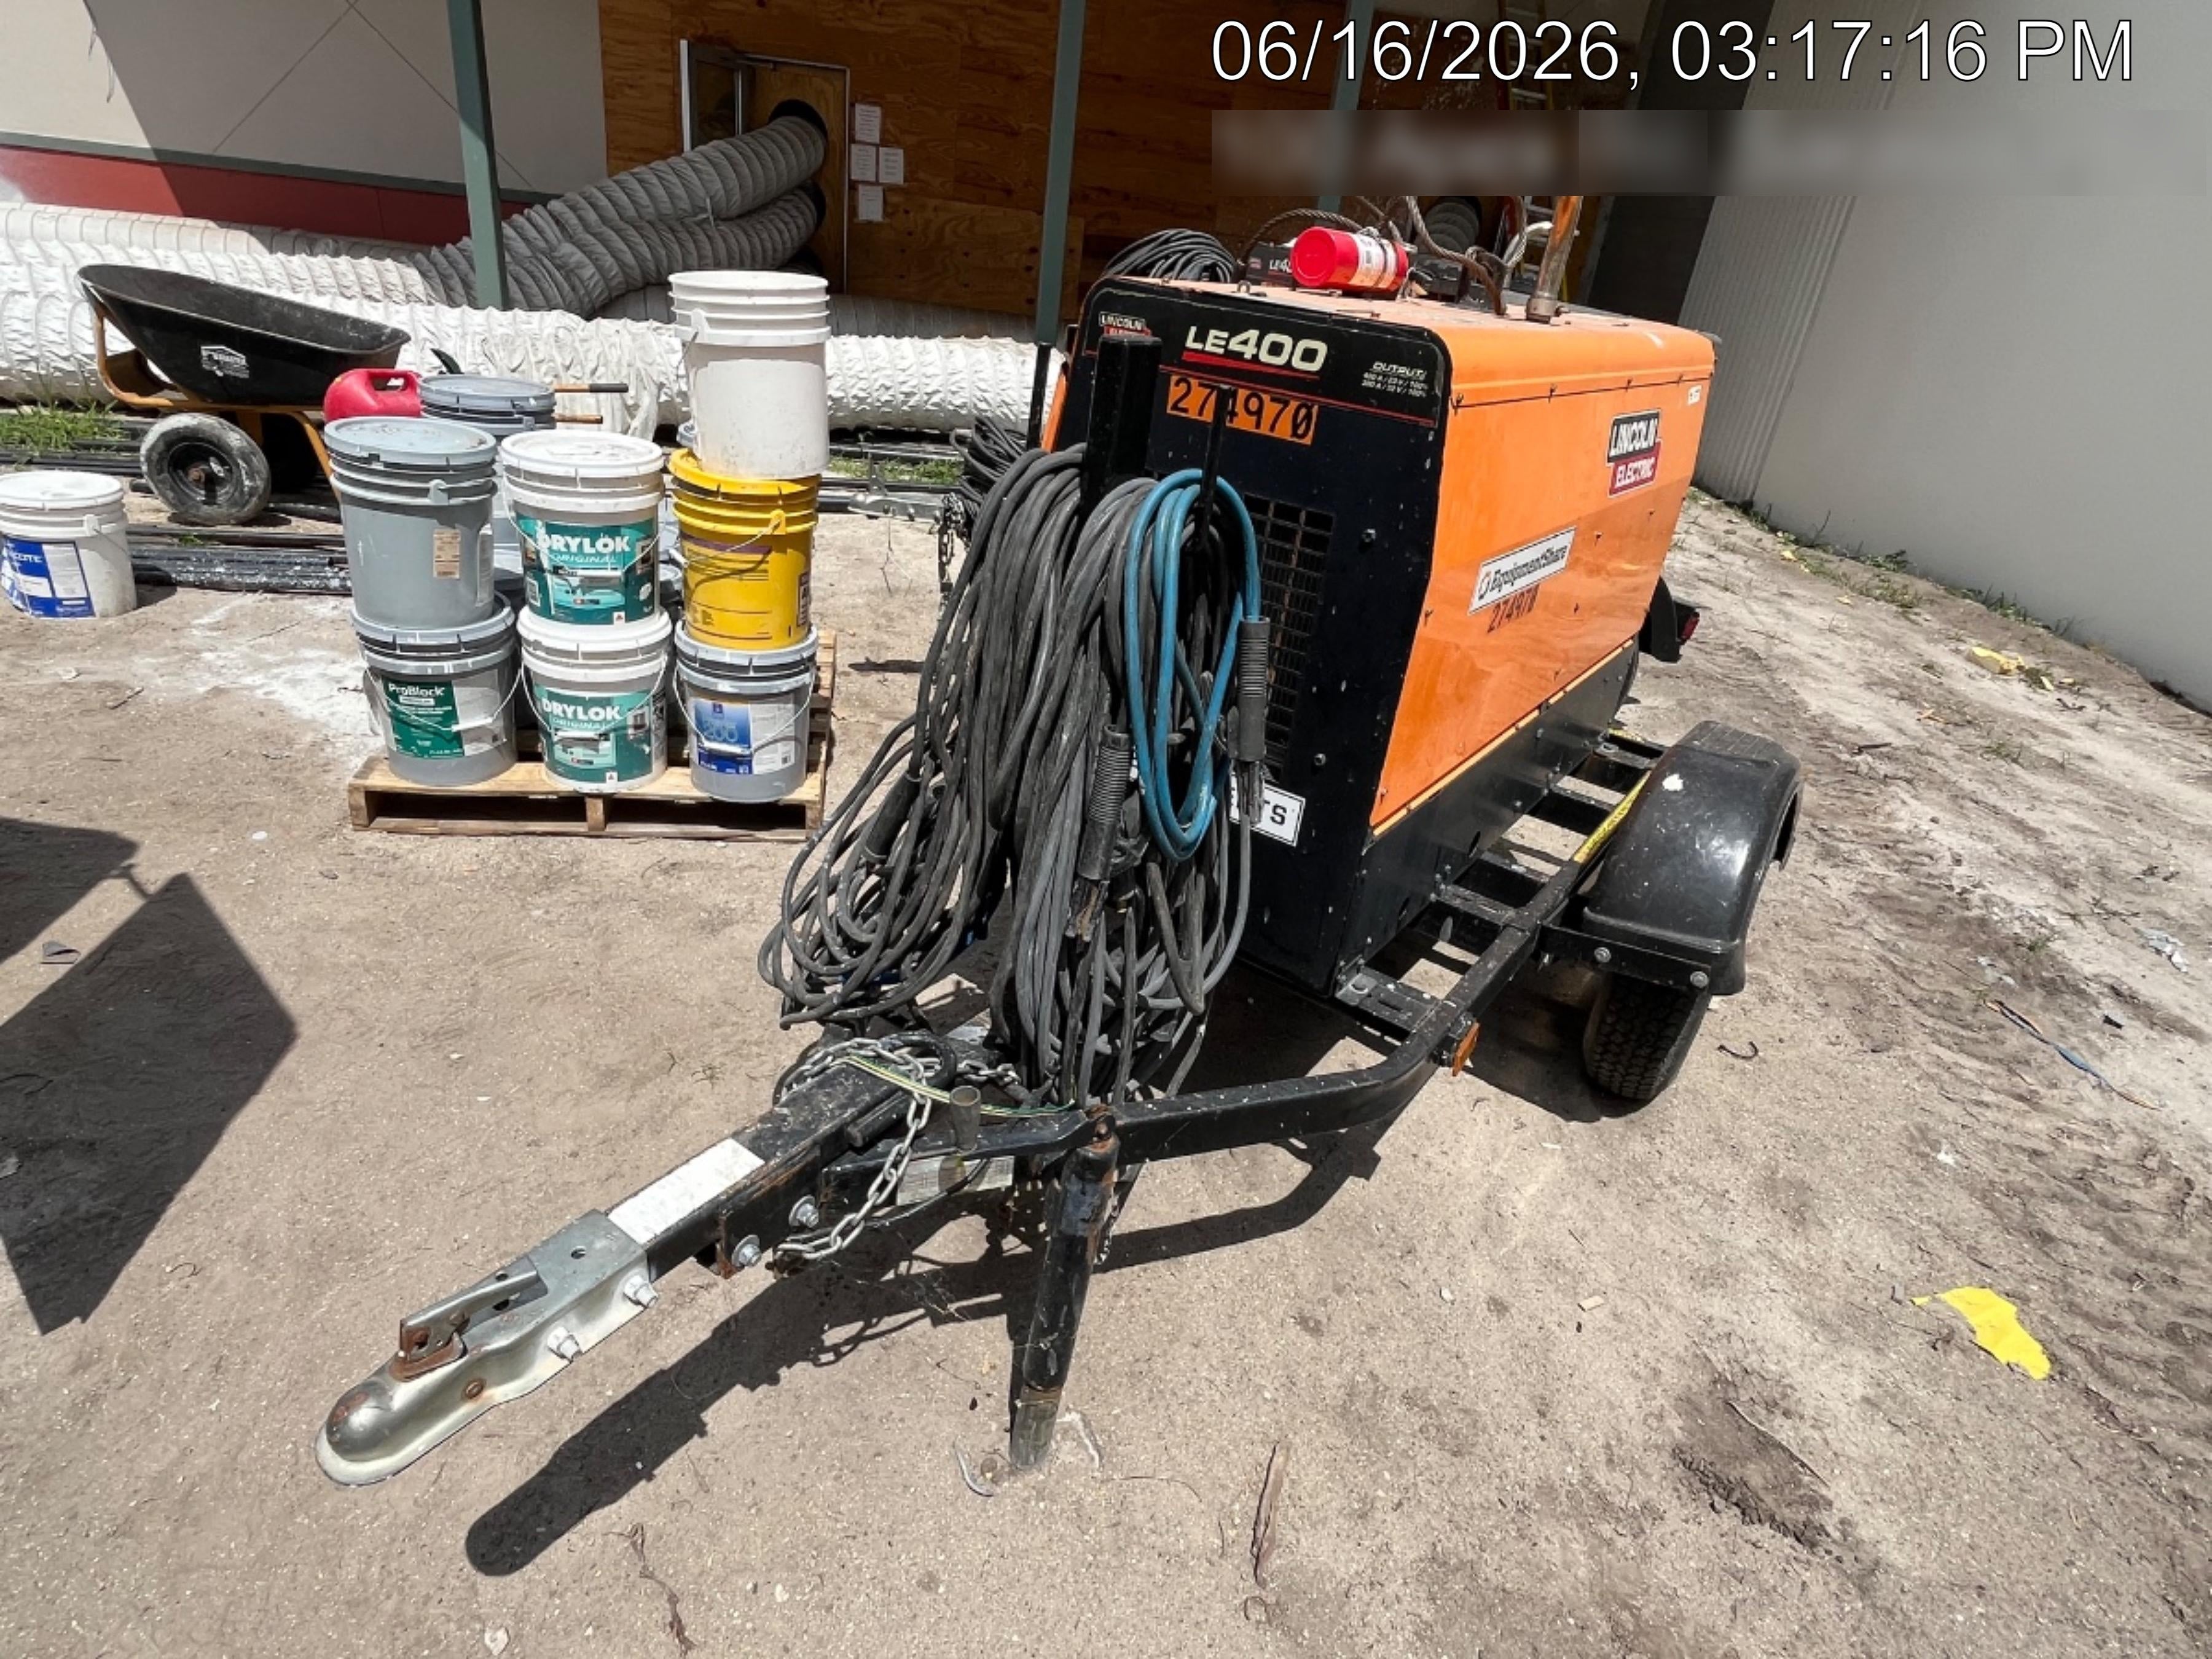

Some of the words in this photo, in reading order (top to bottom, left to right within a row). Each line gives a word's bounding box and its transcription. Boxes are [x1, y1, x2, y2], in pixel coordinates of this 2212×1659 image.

[1185, 326, 1327, 372] LE400
[1609, 418, 1658, 457] LINCOLN
[388, 682, 445, 698] ProBlock
[541, 697, 624, 721] DRYLOK
